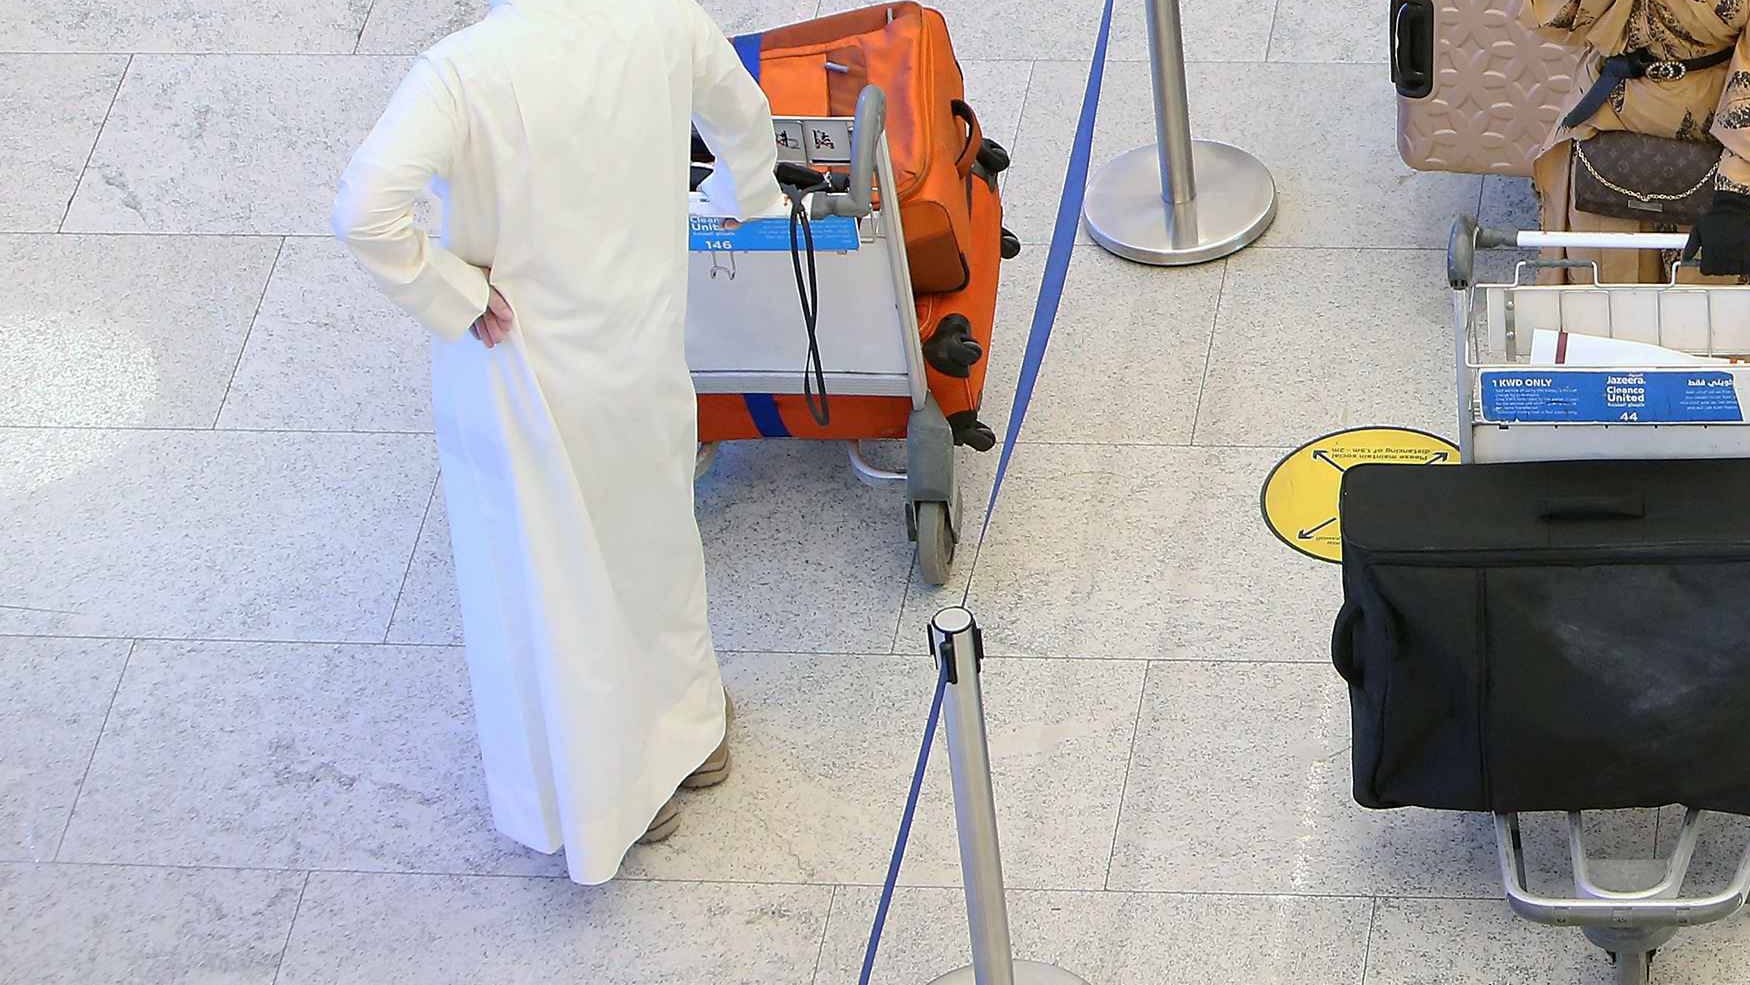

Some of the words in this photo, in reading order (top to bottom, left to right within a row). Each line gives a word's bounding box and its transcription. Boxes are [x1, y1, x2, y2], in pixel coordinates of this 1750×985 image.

[690, 215, 720, 223] Clean
[705, 240, 732, 249] 146
[1492, 379, 1497, 387] 1
[1499, 378, 1523, 387] KWD
[1525, 378, 1552, 387] ONLY
[1607, 394, 1645, 402] United
[1619, 411, 1638, 421] 44
